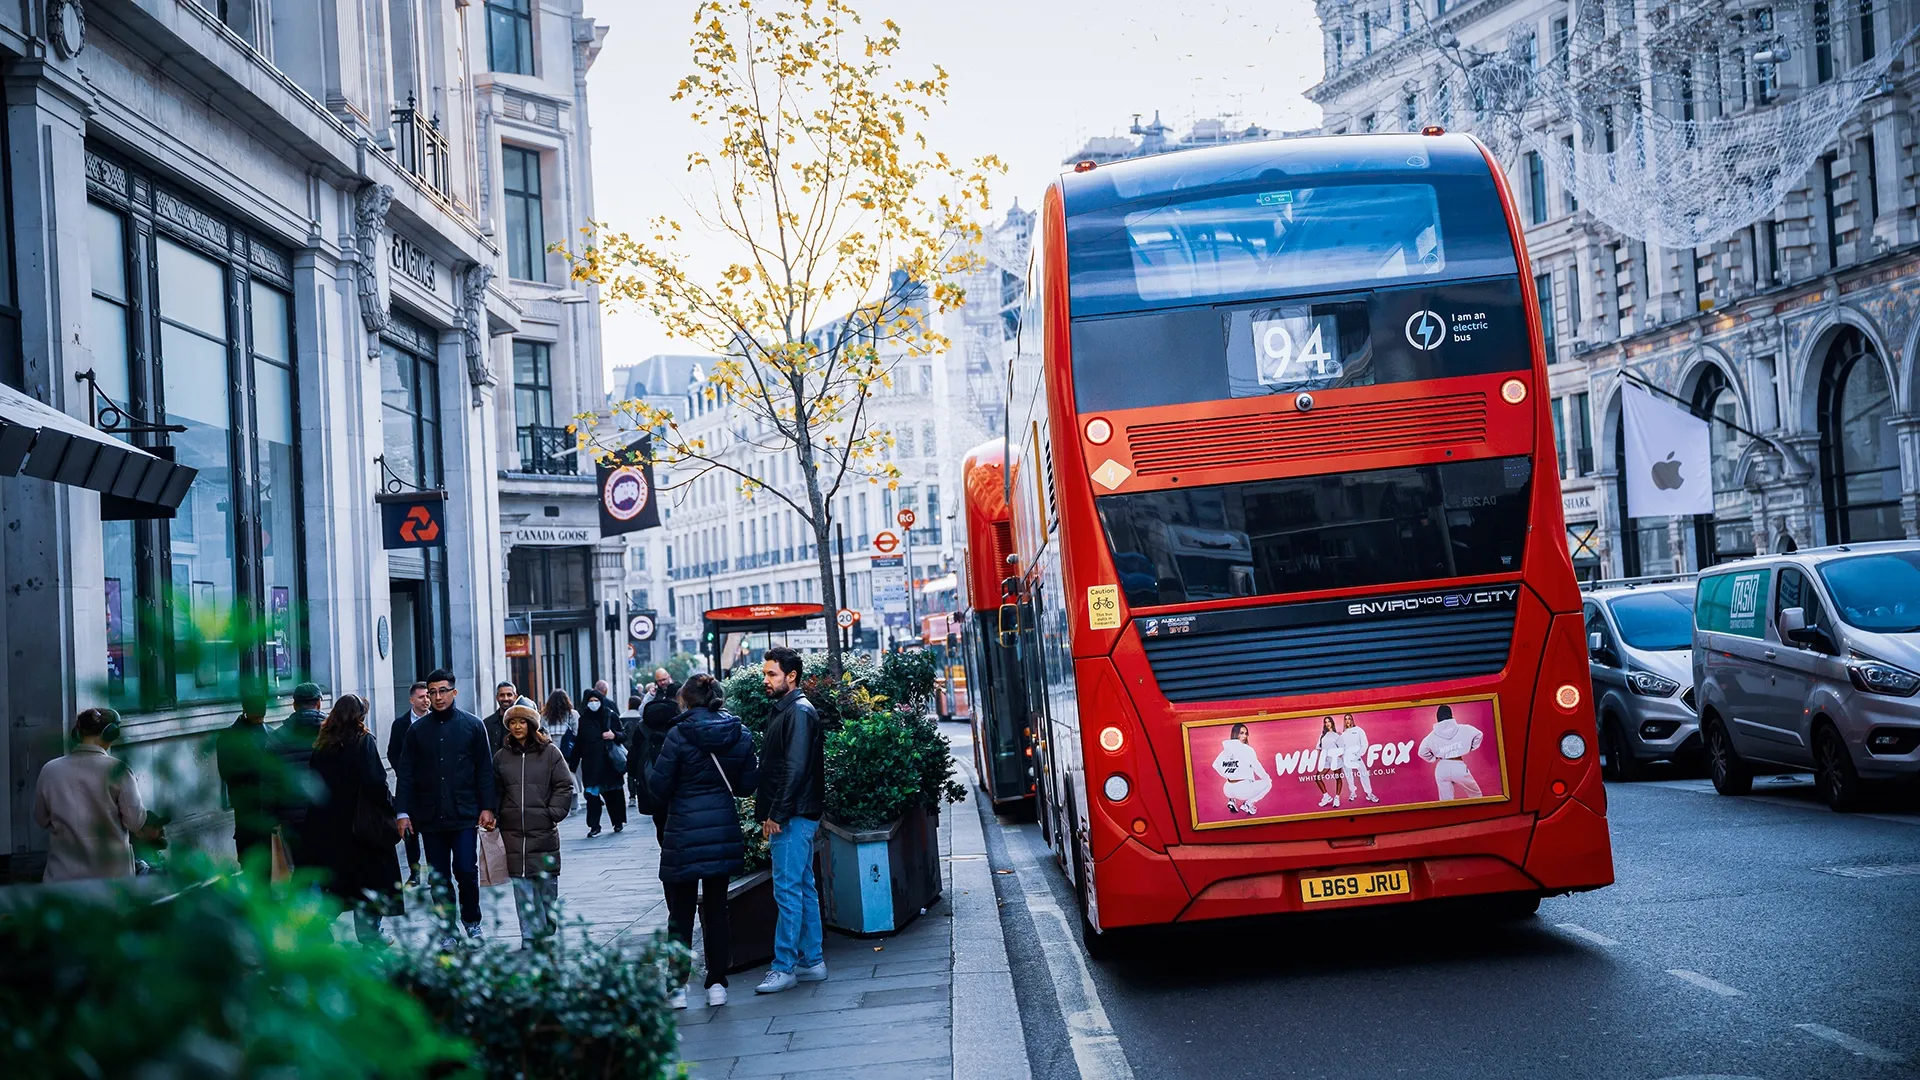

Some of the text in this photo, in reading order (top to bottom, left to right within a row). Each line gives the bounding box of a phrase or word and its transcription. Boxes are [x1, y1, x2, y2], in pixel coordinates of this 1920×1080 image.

[1451, 312, 1486, 322] I am an
[1452, 321, 1488, 332] electric
[1453, 333, 1471, 342] bus
[1263, 322, 1332, 379] 94
[899, 513, 914, 523] RG
[516, 529, 589, 541] CANADA GOOSE
[1732, 577, 1758, 614] TASK
[838, 614, 852, 623] 20
[1275, 740, 1415, 776] WHITE FOX
[1309, 873, 1401, 898] LB69 JRU
